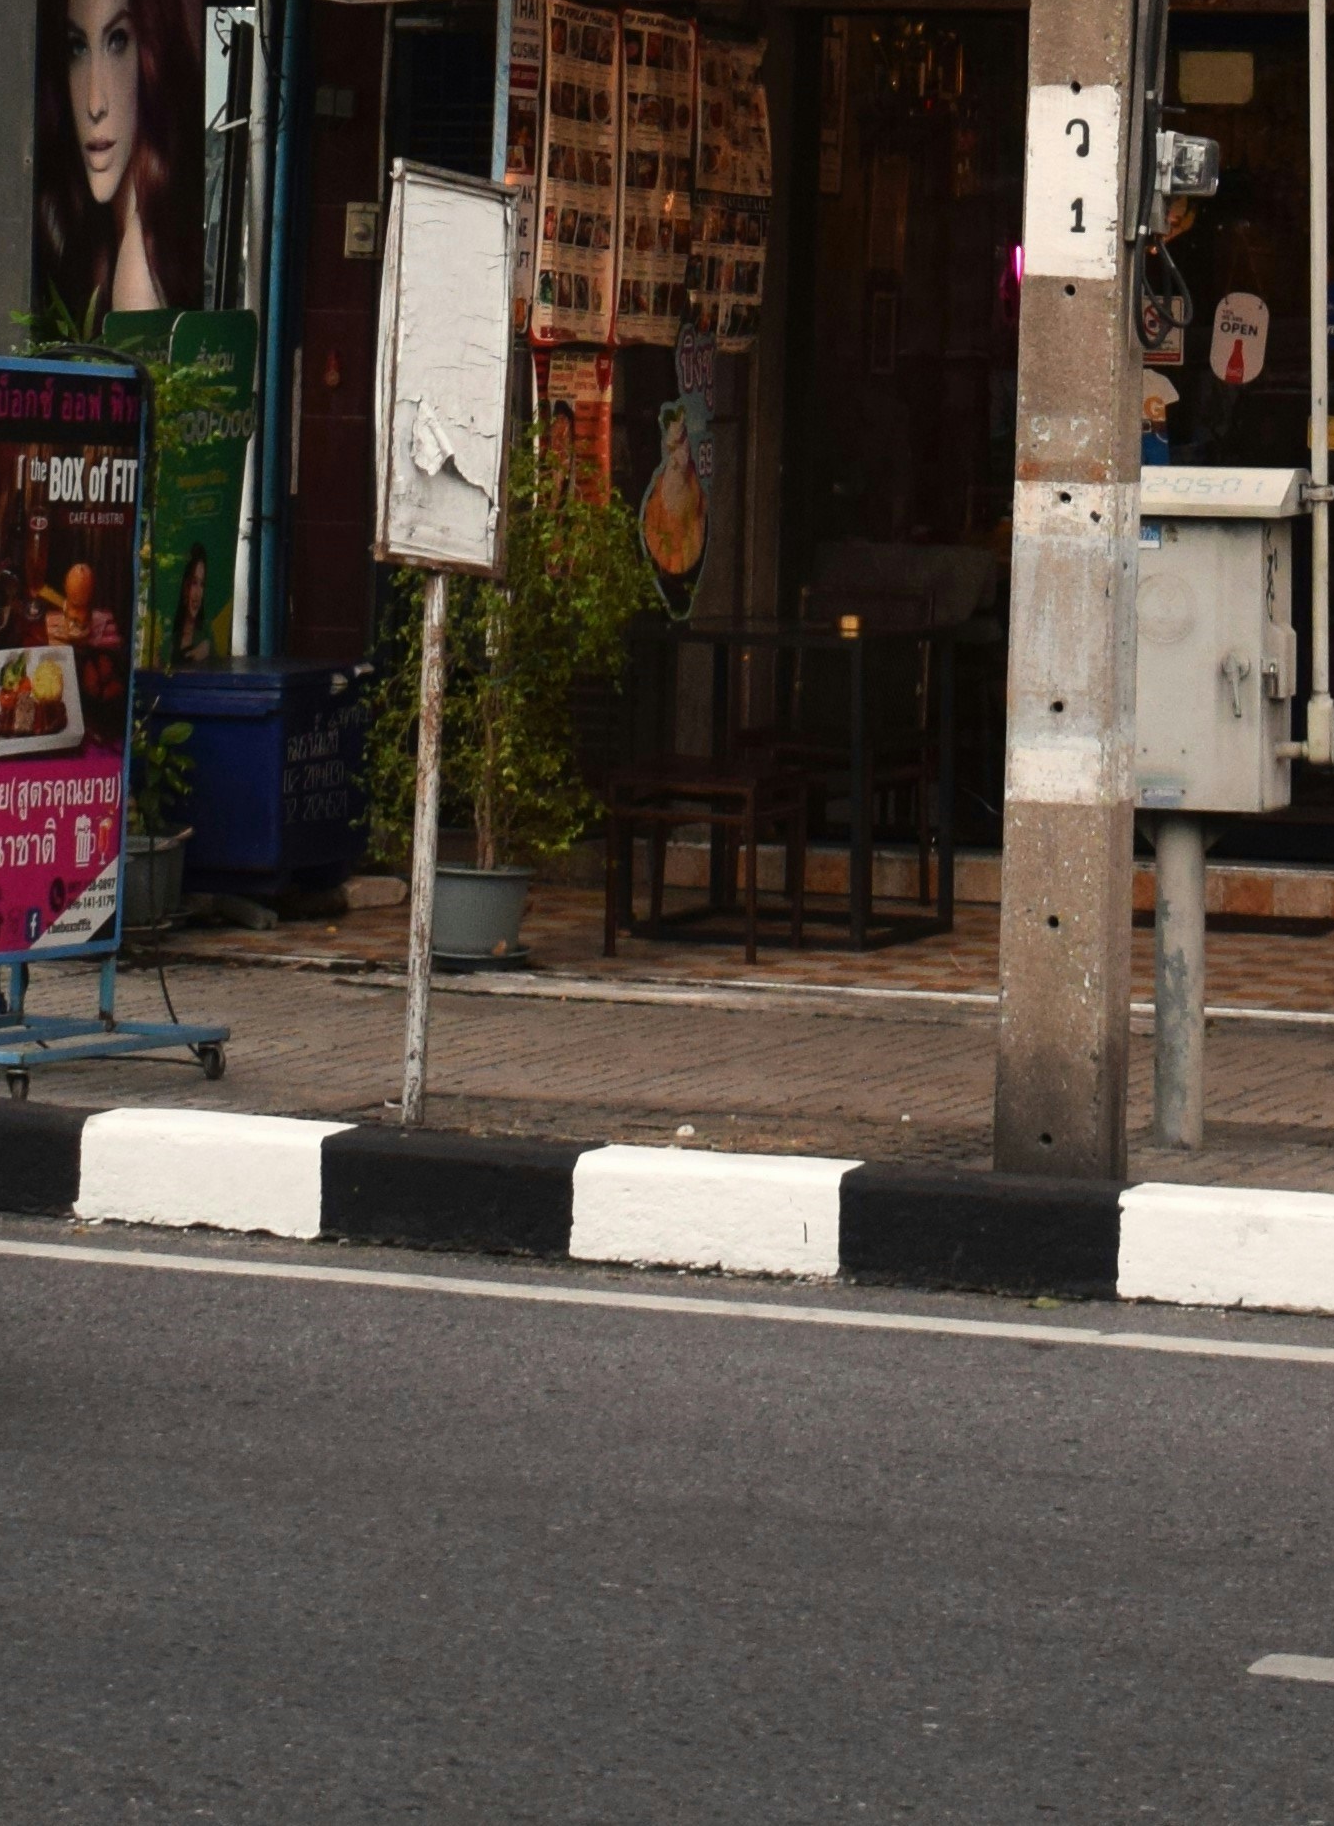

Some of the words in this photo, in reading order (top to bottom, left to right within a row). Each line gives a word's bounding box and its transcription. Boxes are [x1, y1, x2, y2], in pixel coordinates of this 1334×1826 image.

[1069, 197, 1086, 234] 1
[1220, 321, 1258, 336] OPEN
[29, 455, 49, 482] the
[48, 456, 85, 503] BOX
[87, 456, 109, 503] of
[110, 458, 138, 504] FIT
[68, 511, 89, 525] CAFE
[96, 511, 125, 526] BISTRO
